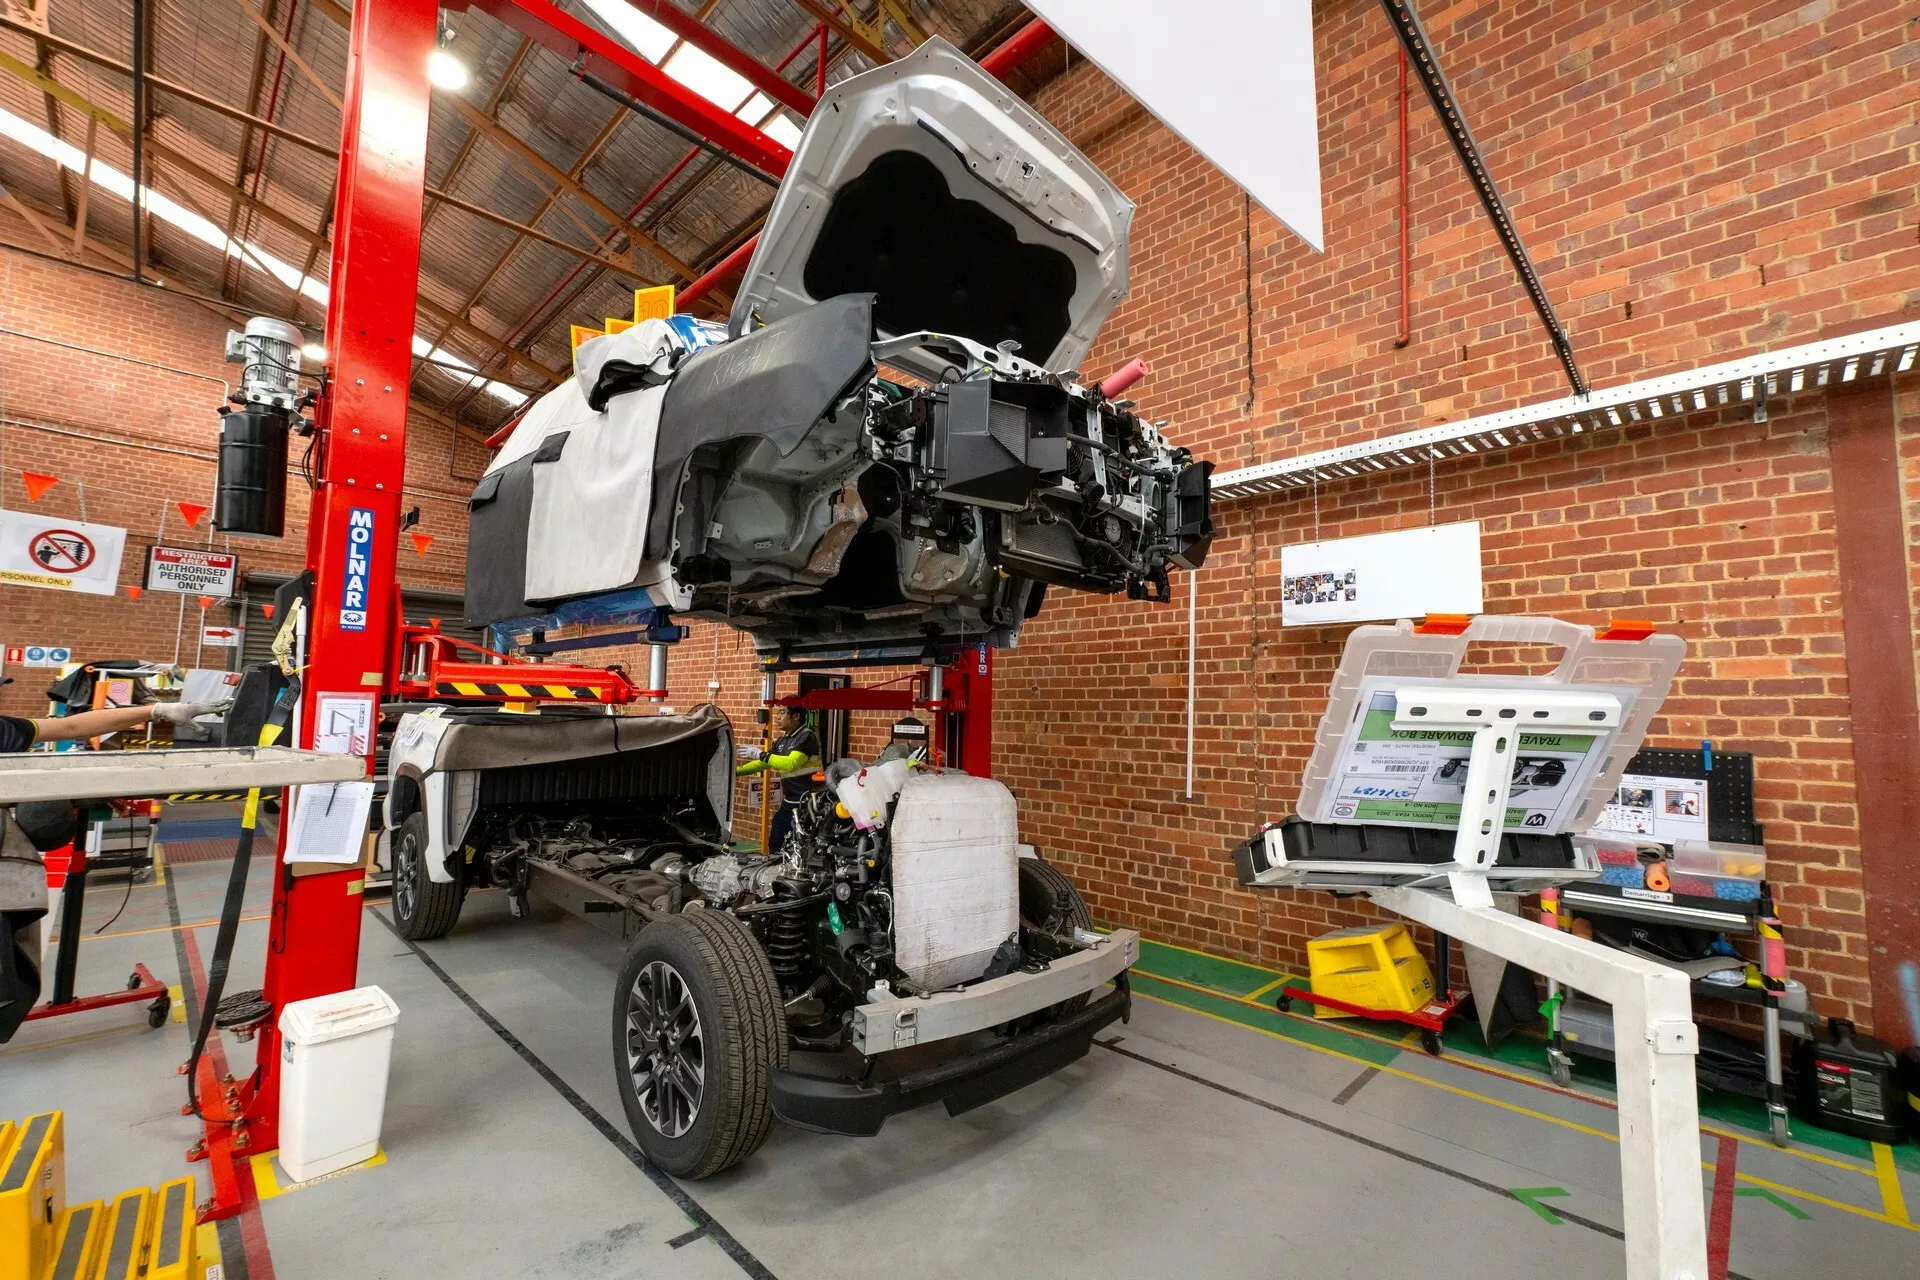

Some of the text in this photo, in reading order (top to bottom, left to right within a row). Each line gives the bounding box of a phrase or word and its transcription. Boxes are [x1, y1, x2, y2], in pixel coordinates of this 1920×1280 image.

[708, 331, 786, 390] RIGHT
[161, 549, 227, 563] RESTRICTED
[179, 557, 209, 566] AREA
[346, 510, 372, 607] MOLNAR
[158, 563, 227, 577] AUTHORISED
[0, 572, 72, 586] RSONNEL ONLY
[160, 571, 224, 585] PERSONNEL
[177, 581, 206, 591] ONLY
[1391, 730, 1417, 739] BOX
[1420, 730, 1477, 741] RDWARE
[1624, 890, 1661, 900] Demarriage
[1818, 1074, 1846, 1085] COOLANT
